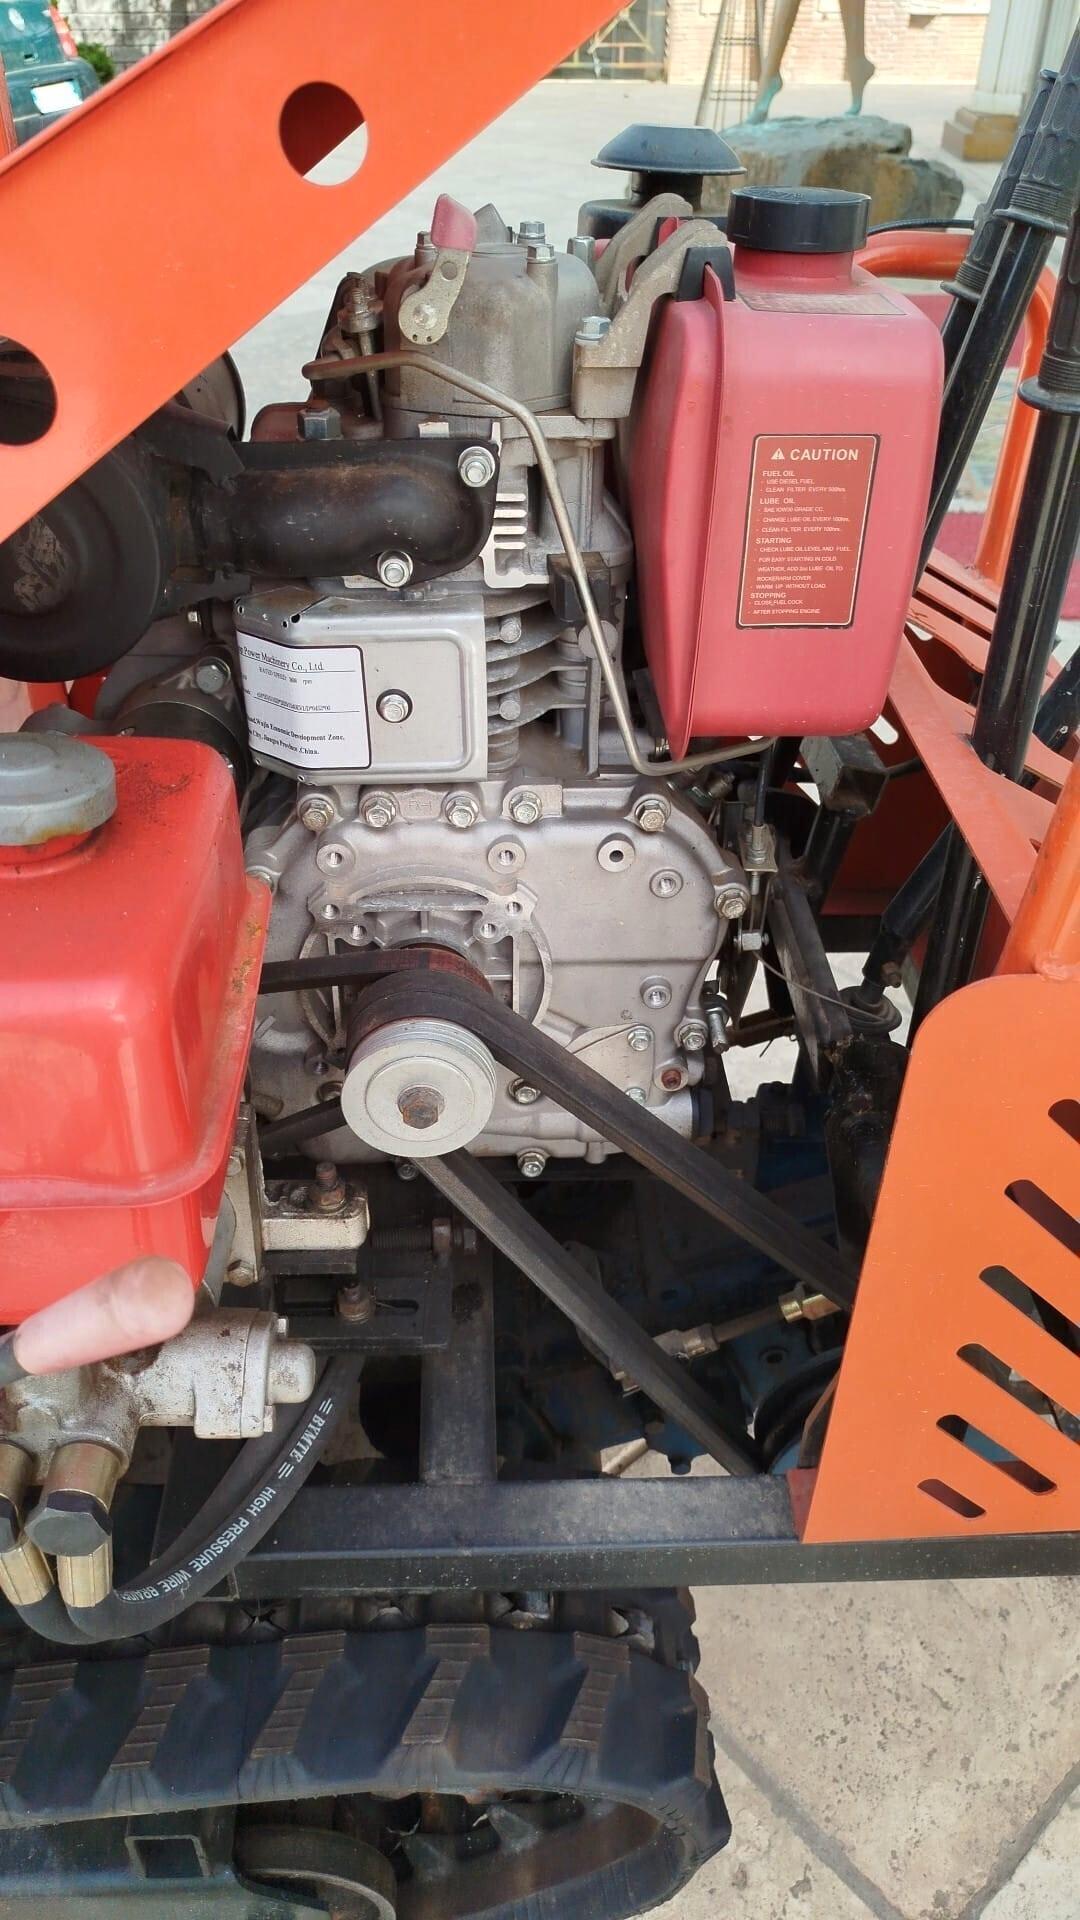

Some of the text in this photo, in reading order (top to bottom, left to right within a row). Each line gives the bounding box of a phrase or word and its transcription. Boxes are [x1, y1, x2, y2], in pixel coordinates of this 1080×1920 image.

[790, 449, 859, 461] CAUTION
[244, 646, 260, 659] Power
[262, 652, 290, 670] Machinery
[290, 730, 326, 742] Development
[290, 1414, 326, 1462] BYMTE
[246, 1486, 276, 1516] HIGH
[188, 1516, 250, 1572] PRESSURE
[157, 1570, 192, 1592] WIRE
